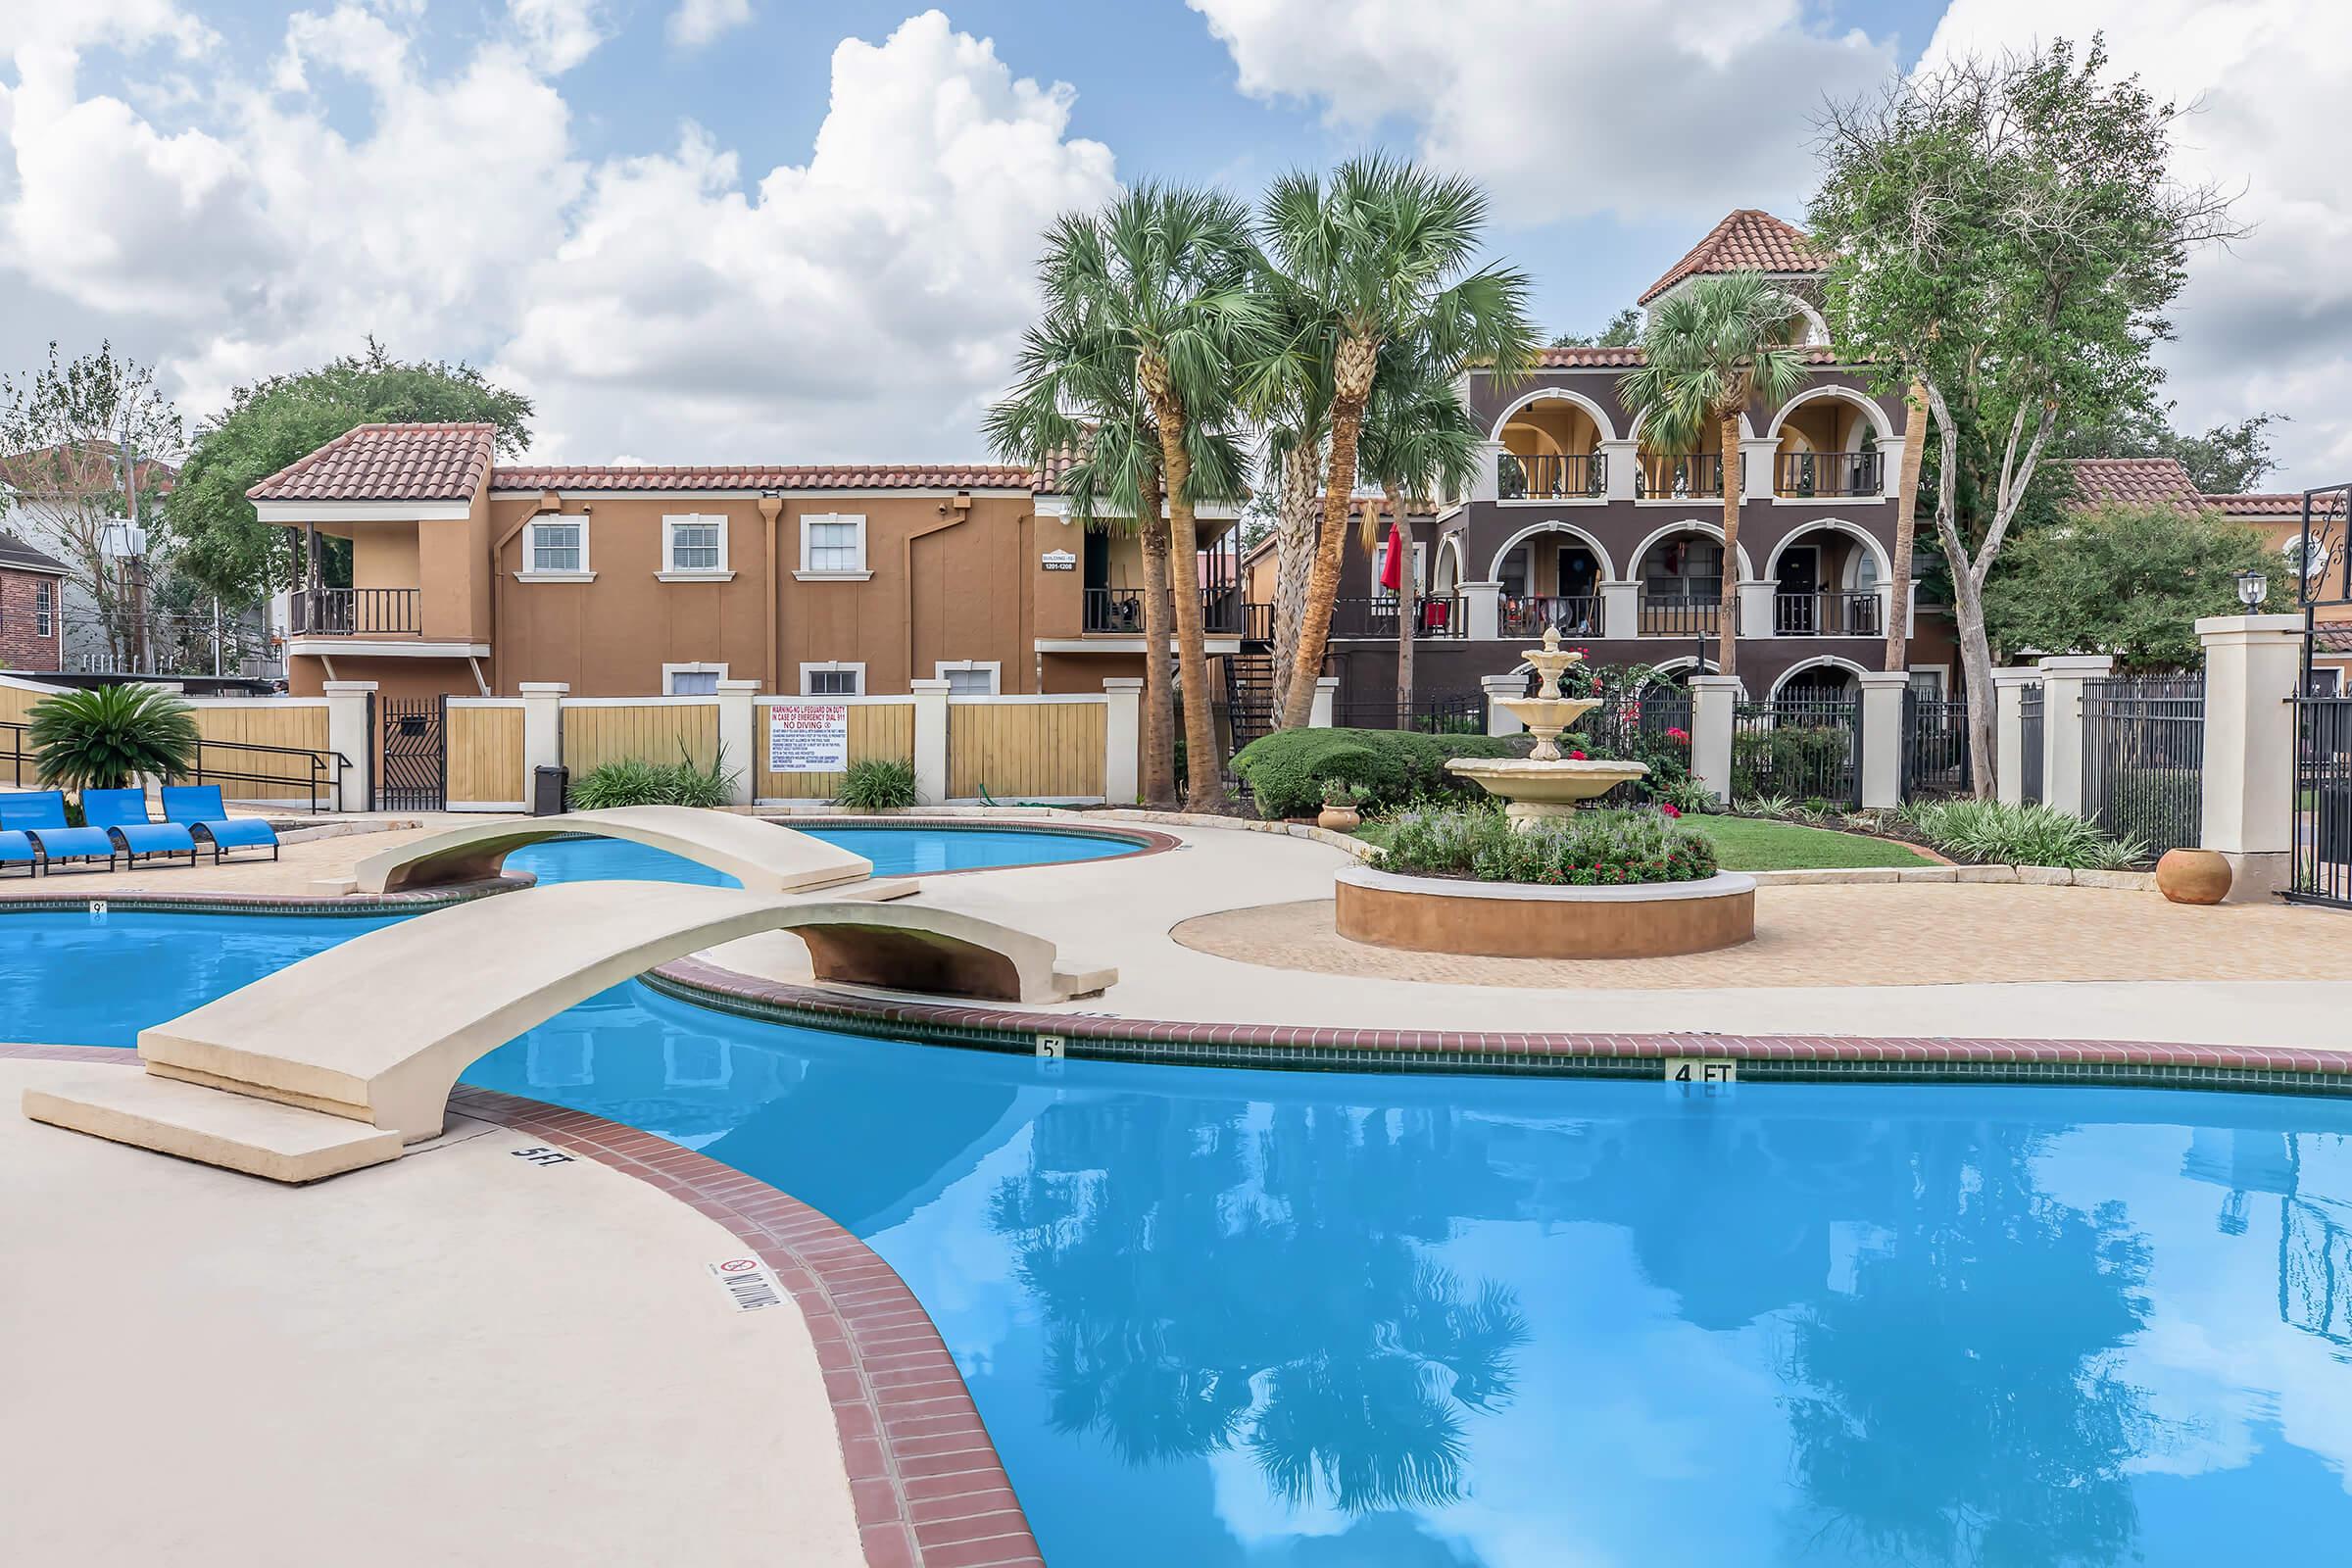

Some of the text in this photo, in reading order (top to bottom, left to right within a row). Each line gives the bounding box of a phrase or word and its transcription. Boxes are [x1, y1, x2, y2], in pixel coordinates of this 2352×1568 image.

[1043, 1039, 1059, 1057] 5'
[1675, 1064, 1733, 1082] 4 FT
[722, 1272, 781, 1309] NO DIVING
